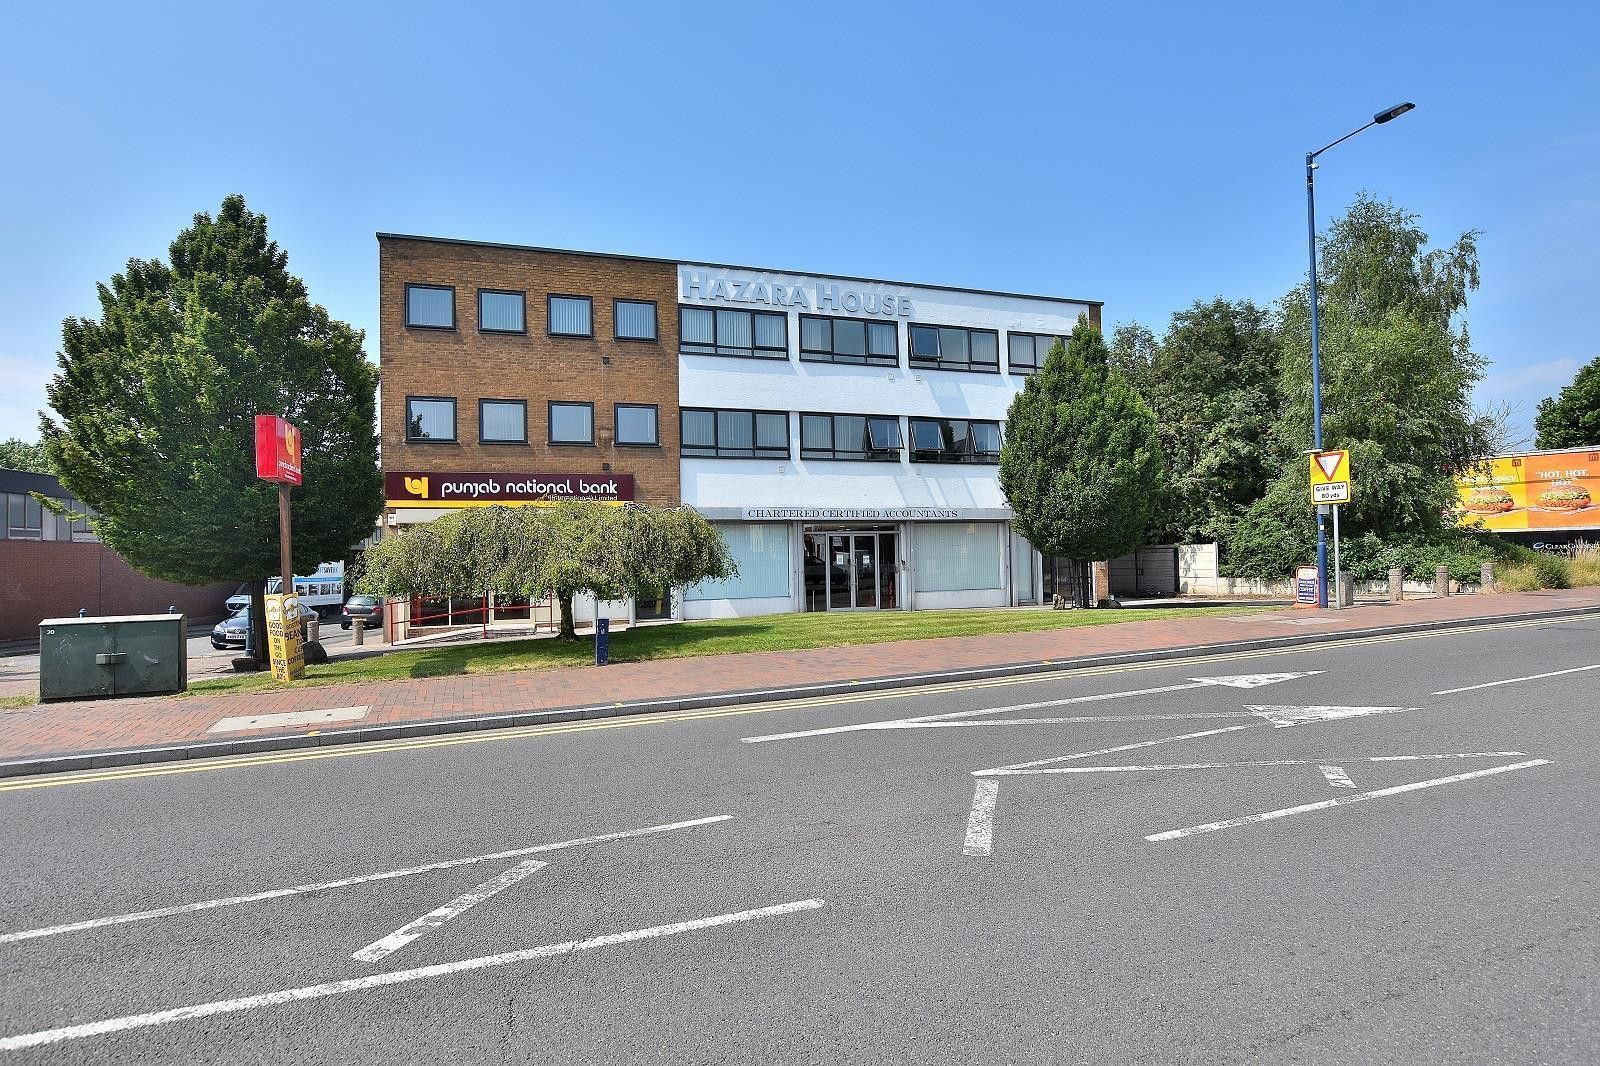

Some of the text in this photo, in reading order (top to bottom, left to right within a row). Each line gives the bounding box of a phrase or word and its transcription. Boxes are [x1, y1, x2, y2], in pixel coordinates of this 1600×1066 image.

[682, 270, 912, 317] HAZARA HOUSE
[441, 479, 618, 498] punjab national bank
[748, 509, 959, 518] CHARTERED CERTIFIED ACCOUNTANTS
[268, 621, 283, 630] GOOD
[269, 629, 284, 638] FOOD
